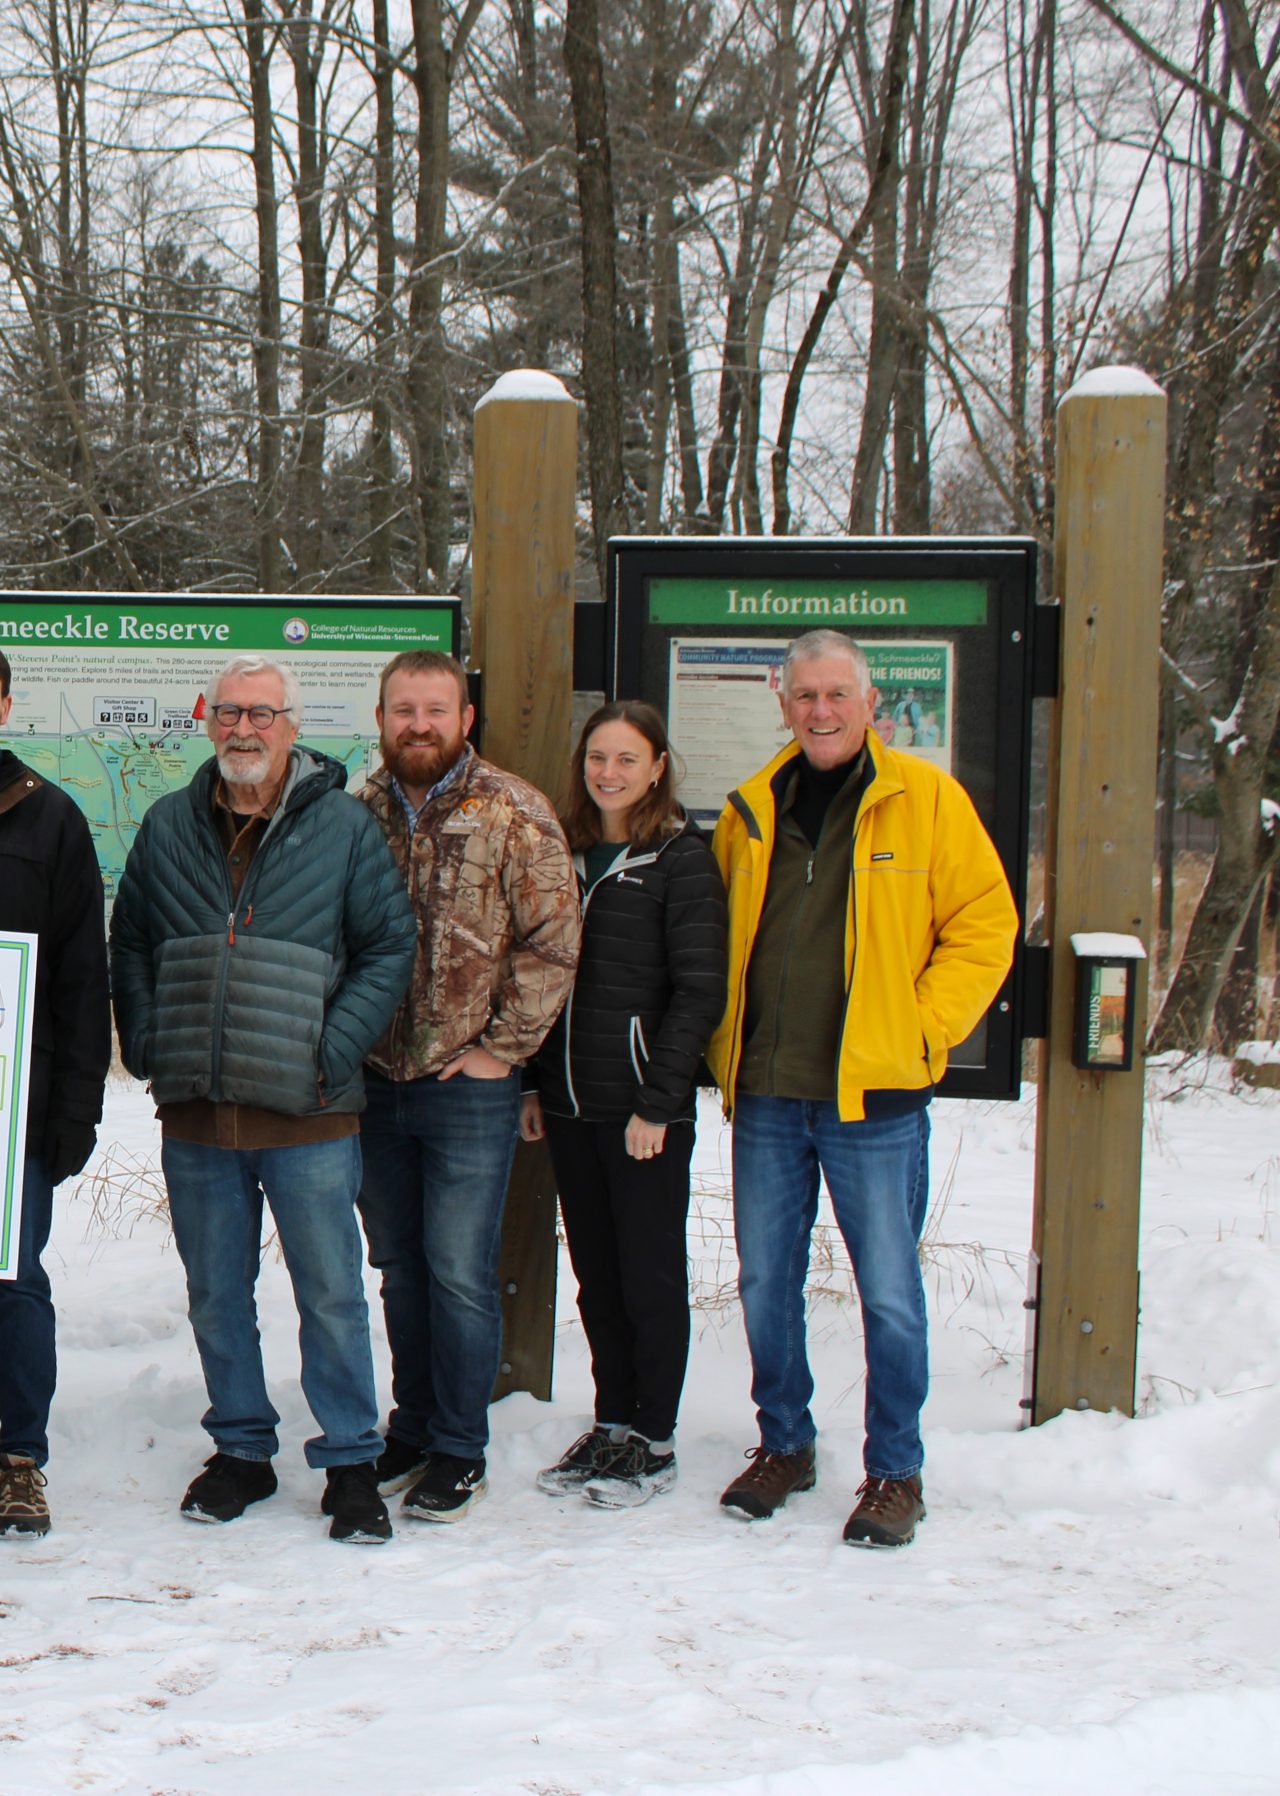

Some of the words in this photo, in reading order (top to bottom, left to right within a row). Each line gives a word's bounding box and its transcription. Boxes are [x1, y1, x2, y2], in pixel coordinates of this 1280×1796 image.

[727, 589, 908, 616] Information
[118, 615, 230, 641] Reserve
[311, 624, 339, 634] College
[350, 625, 376, 633] Natural
[378, 625, 417, 633] Resources
[311, 633, 348, 641] University
[4, 653, 49, 663] W-Stevens
[51, 654, 81, 663] Point's
[83, 654, 115, 664] natural
[117, 657, 153, 666] campus.
[156, 657, 170, 665] This
[294, 660, 328, 668] ecological
[329, 660, 372, 668] communities
[301, 670, 328, 678] prairies,
[890, 667, 944, 680] FRIENDS!
